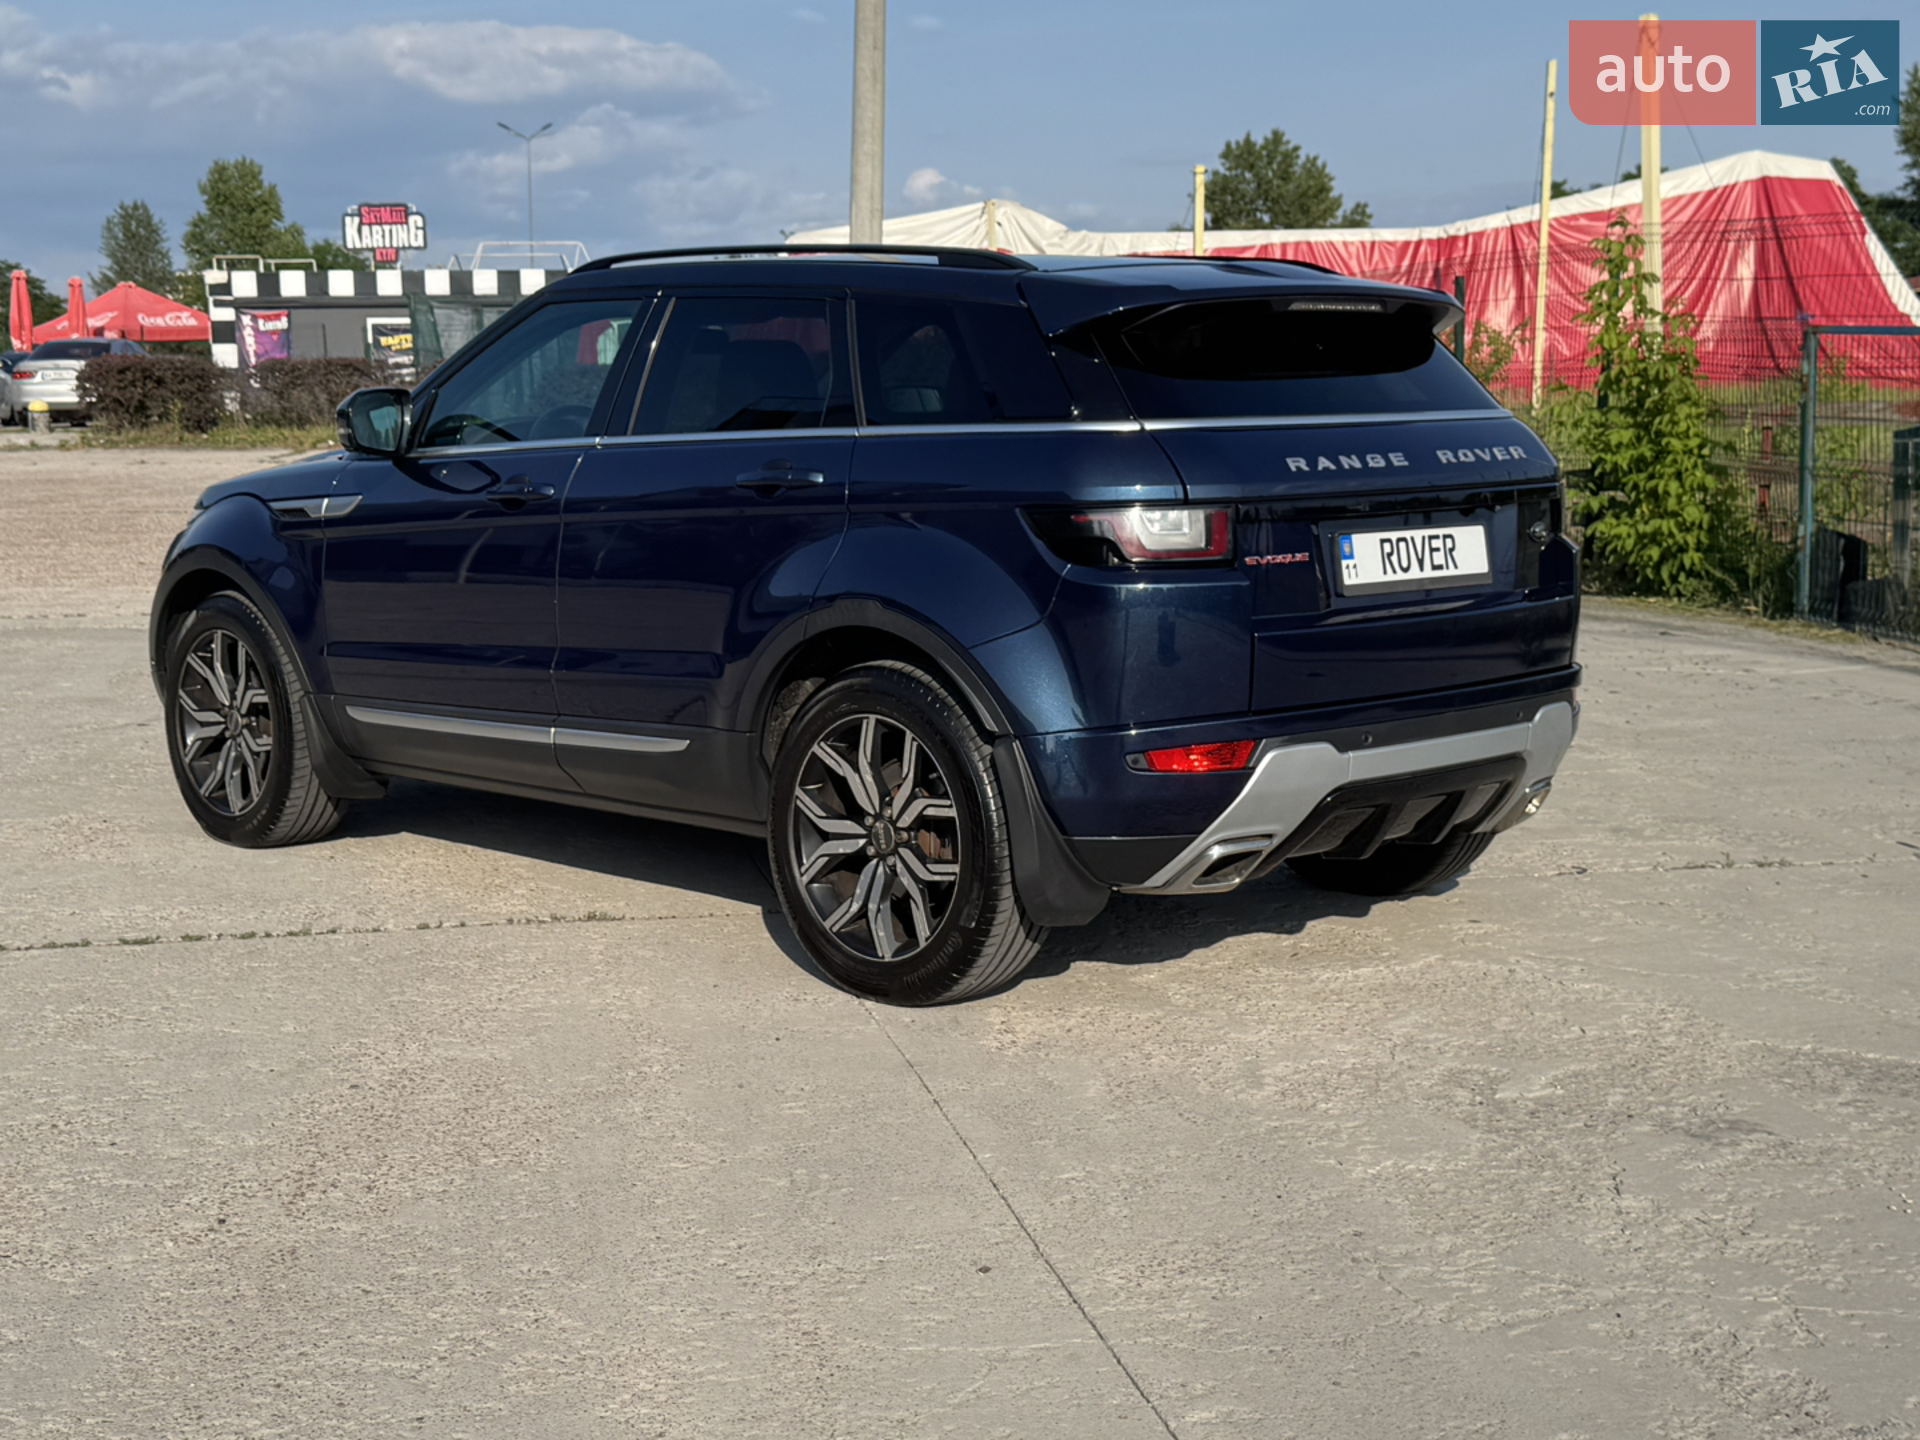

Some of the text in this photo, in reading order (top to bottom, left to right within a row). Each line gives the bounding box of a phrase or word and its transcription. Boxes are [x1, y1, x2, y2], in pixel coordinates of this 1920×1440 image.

[344, 214, 425, 249] KARTING
[1285, 445, 1528, 473] RANGE ROVER
[1244, 552, 1310, 565] EVOQUE
[1379, 533, 1459, 576] ROVER
[1344, 563, 1359, 580] 11
